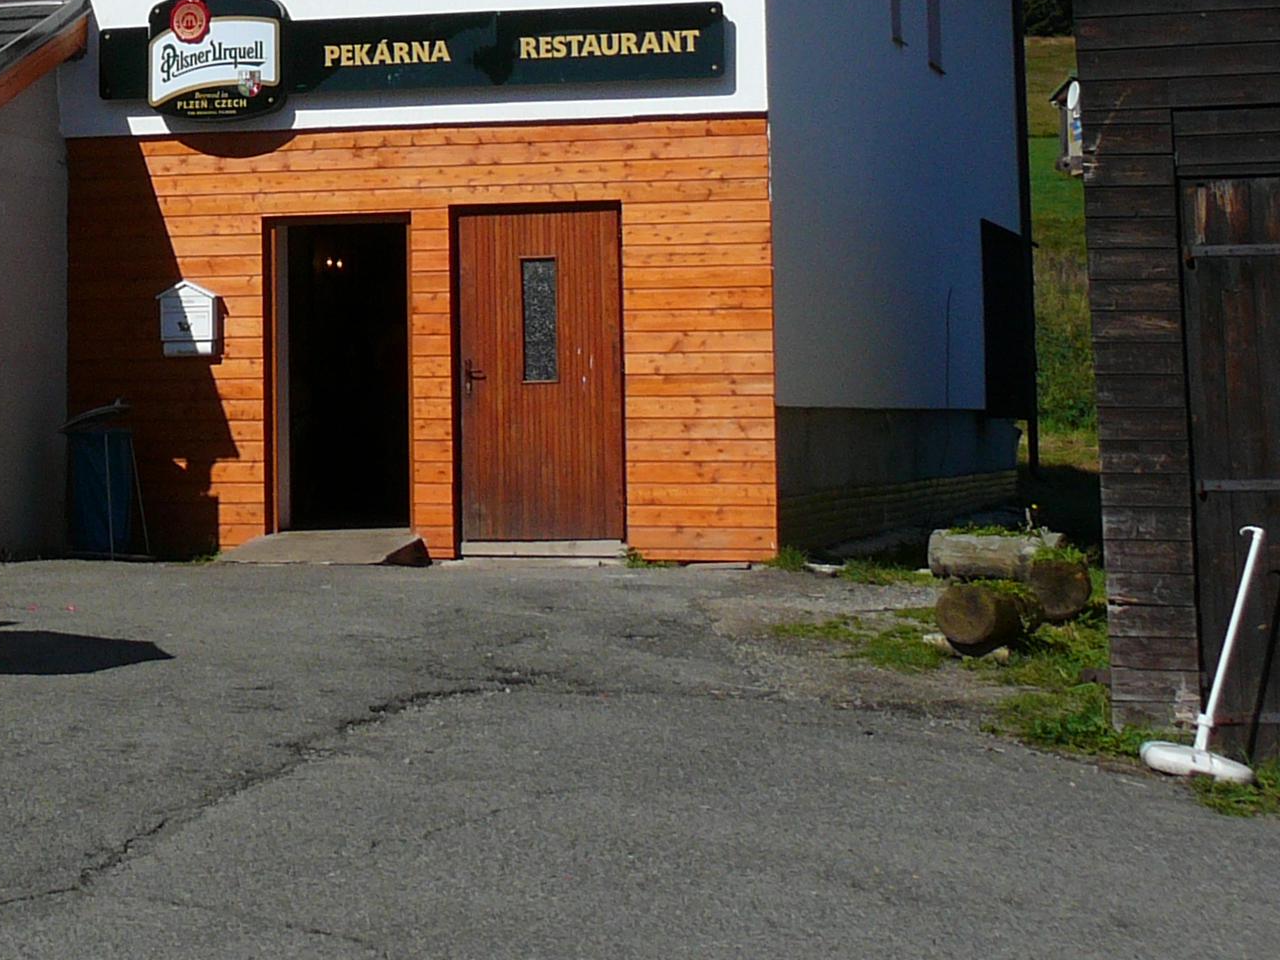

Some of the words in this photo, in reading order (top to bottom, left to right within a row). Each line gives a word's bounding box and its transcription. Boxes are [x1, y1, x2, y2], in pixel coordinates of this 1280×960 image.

[161, 43, 211, 83] Pilsner
[210, 40, 264, 69] Urquell
[323, 39, 451, 67] PEKÁRNA
[519, 30, 700, 59] RESTAURANT
[214, 98, 247, 108] CZECH
